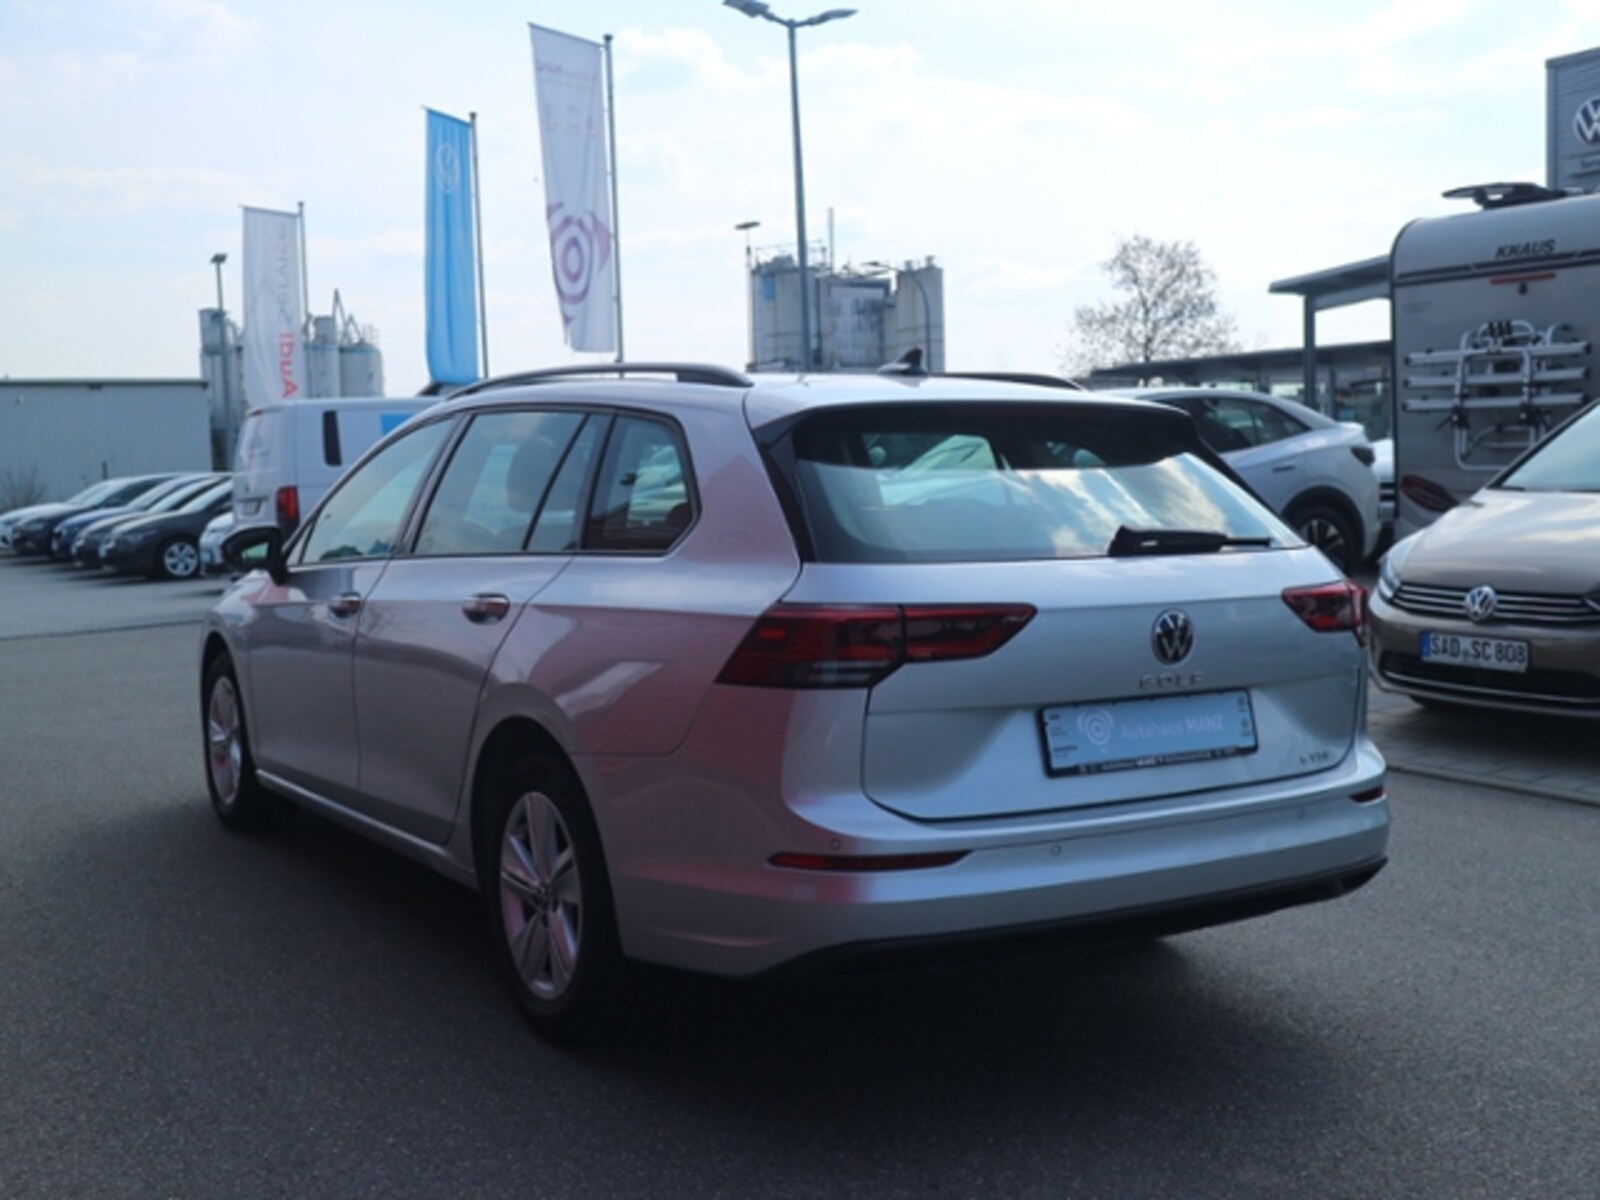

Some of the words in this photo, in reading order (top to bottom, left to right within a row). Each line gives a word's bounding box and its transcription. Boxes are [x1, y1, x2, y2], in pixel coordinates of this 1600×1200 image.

[1495, 238, 1556, 259] KNAUS
[1431, 635, 1461, 658] SAD
[1471, 640, 1491, 660] SC
[1495, 642, 1526, 663] 808
[1139, 671, 1203, 688] GOLF
[1120, 722, 1183, 739] Autohaus
[1186, 714, 1224, 732] MANZ
